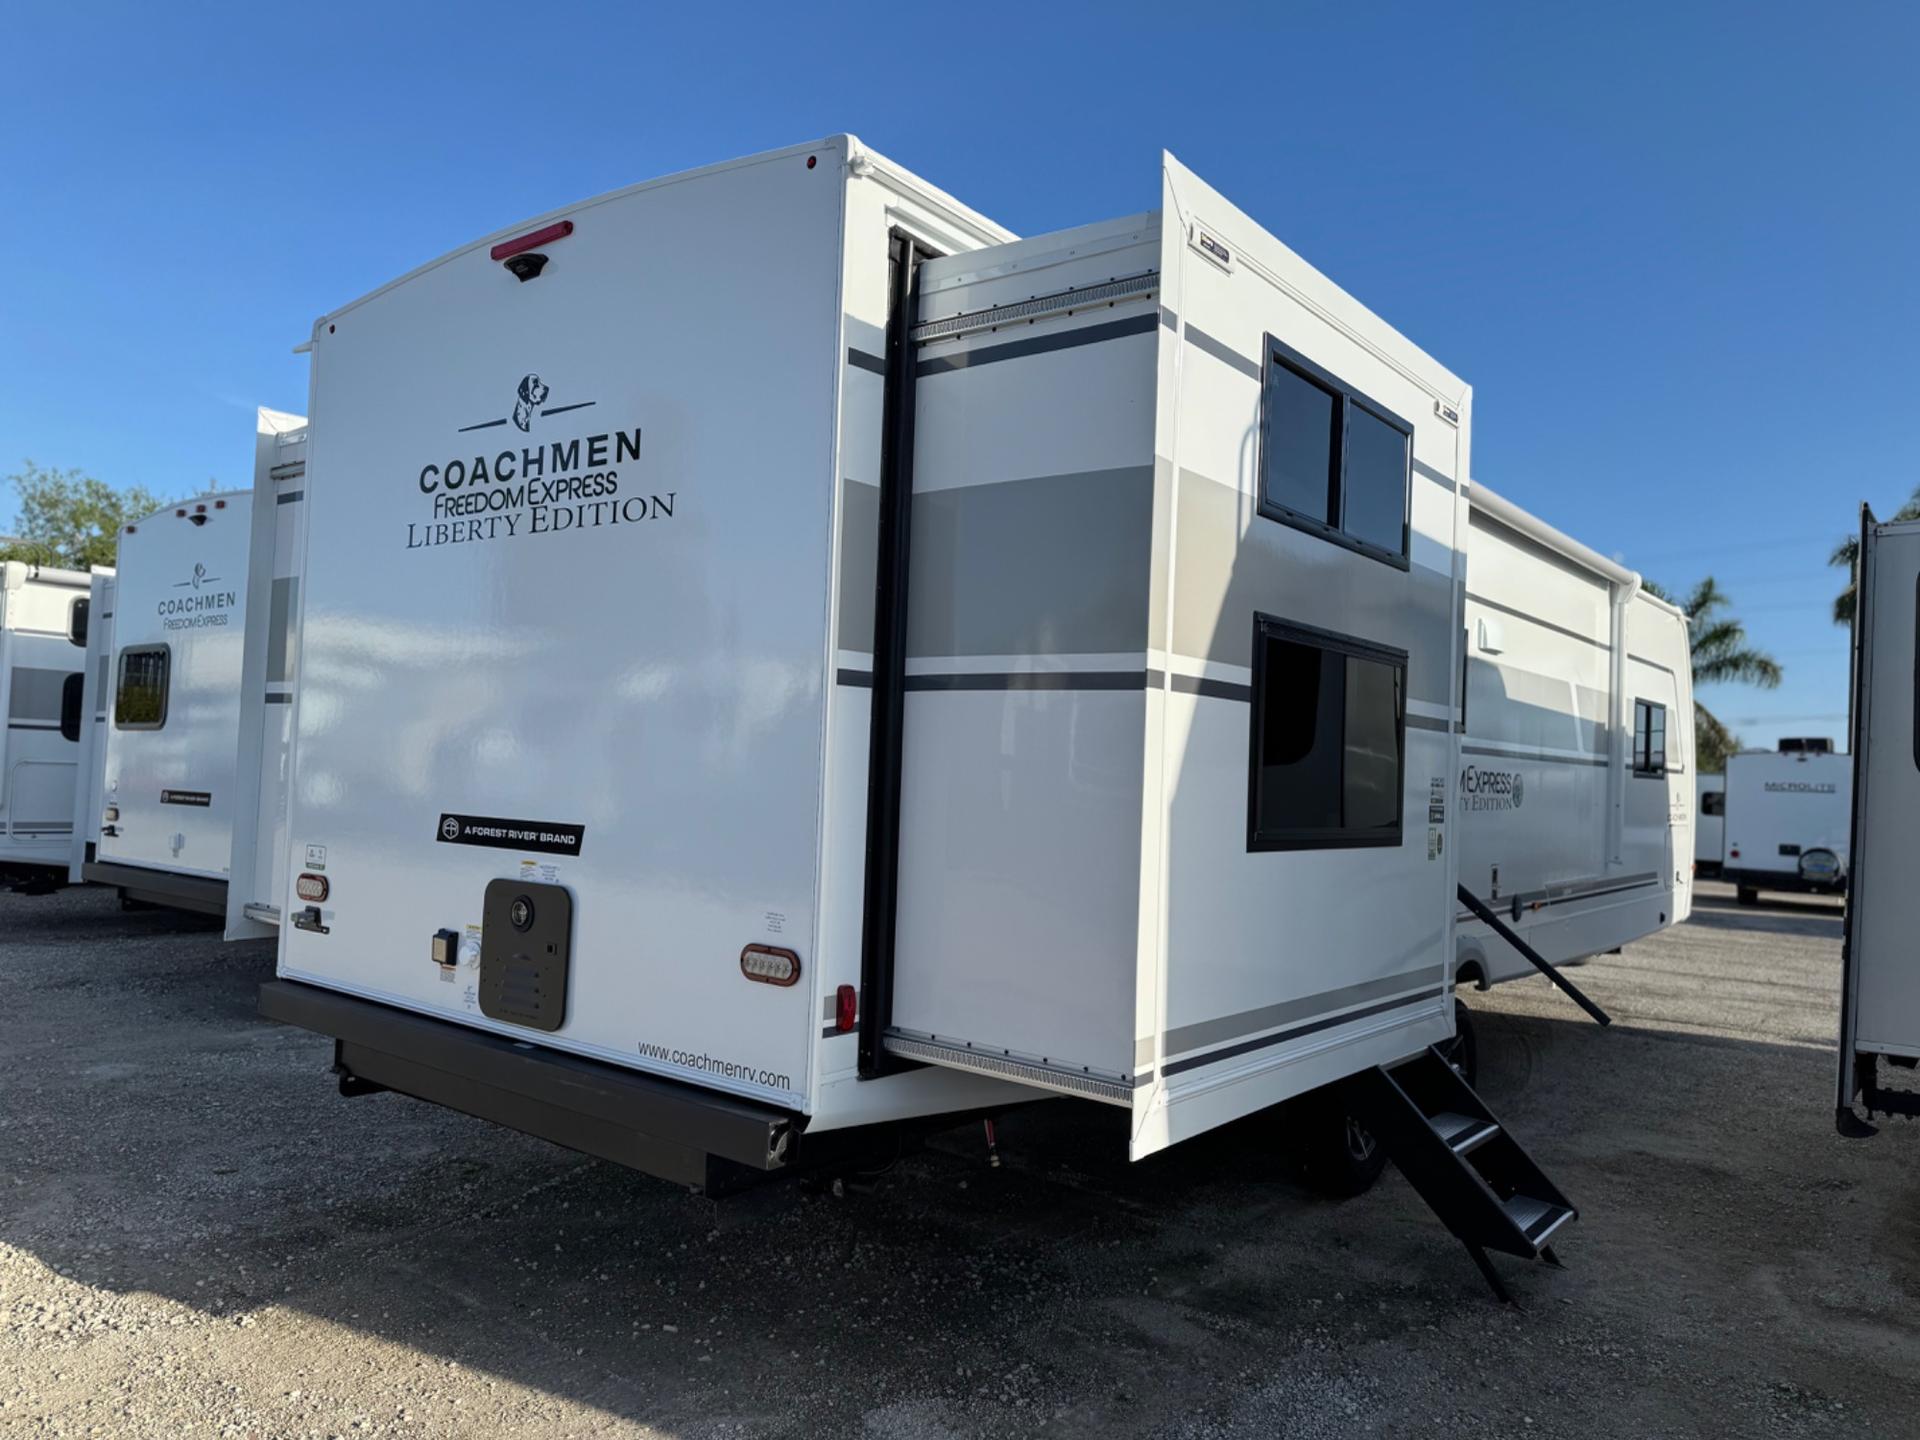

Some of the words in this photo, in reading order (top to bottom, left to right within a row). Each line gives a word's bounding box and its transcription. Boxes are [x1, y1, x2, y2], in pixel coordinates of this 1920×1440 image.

[419, 428, 641, 493] COACHMEN
[406, 513, 522, 549] LIBERTY
[528, 493, 677, 533] EDITION
[158, 591, 236, 615] COACHMEN
[1764, 781, 1836, 793] MICROLITE
[464, 826, 471, 835] A
[472, 826, 507, 838] FOREST
[540, 833, 576, 845] BRAND
[638, 1041, 791, 1091] www.coachmenrv.com
